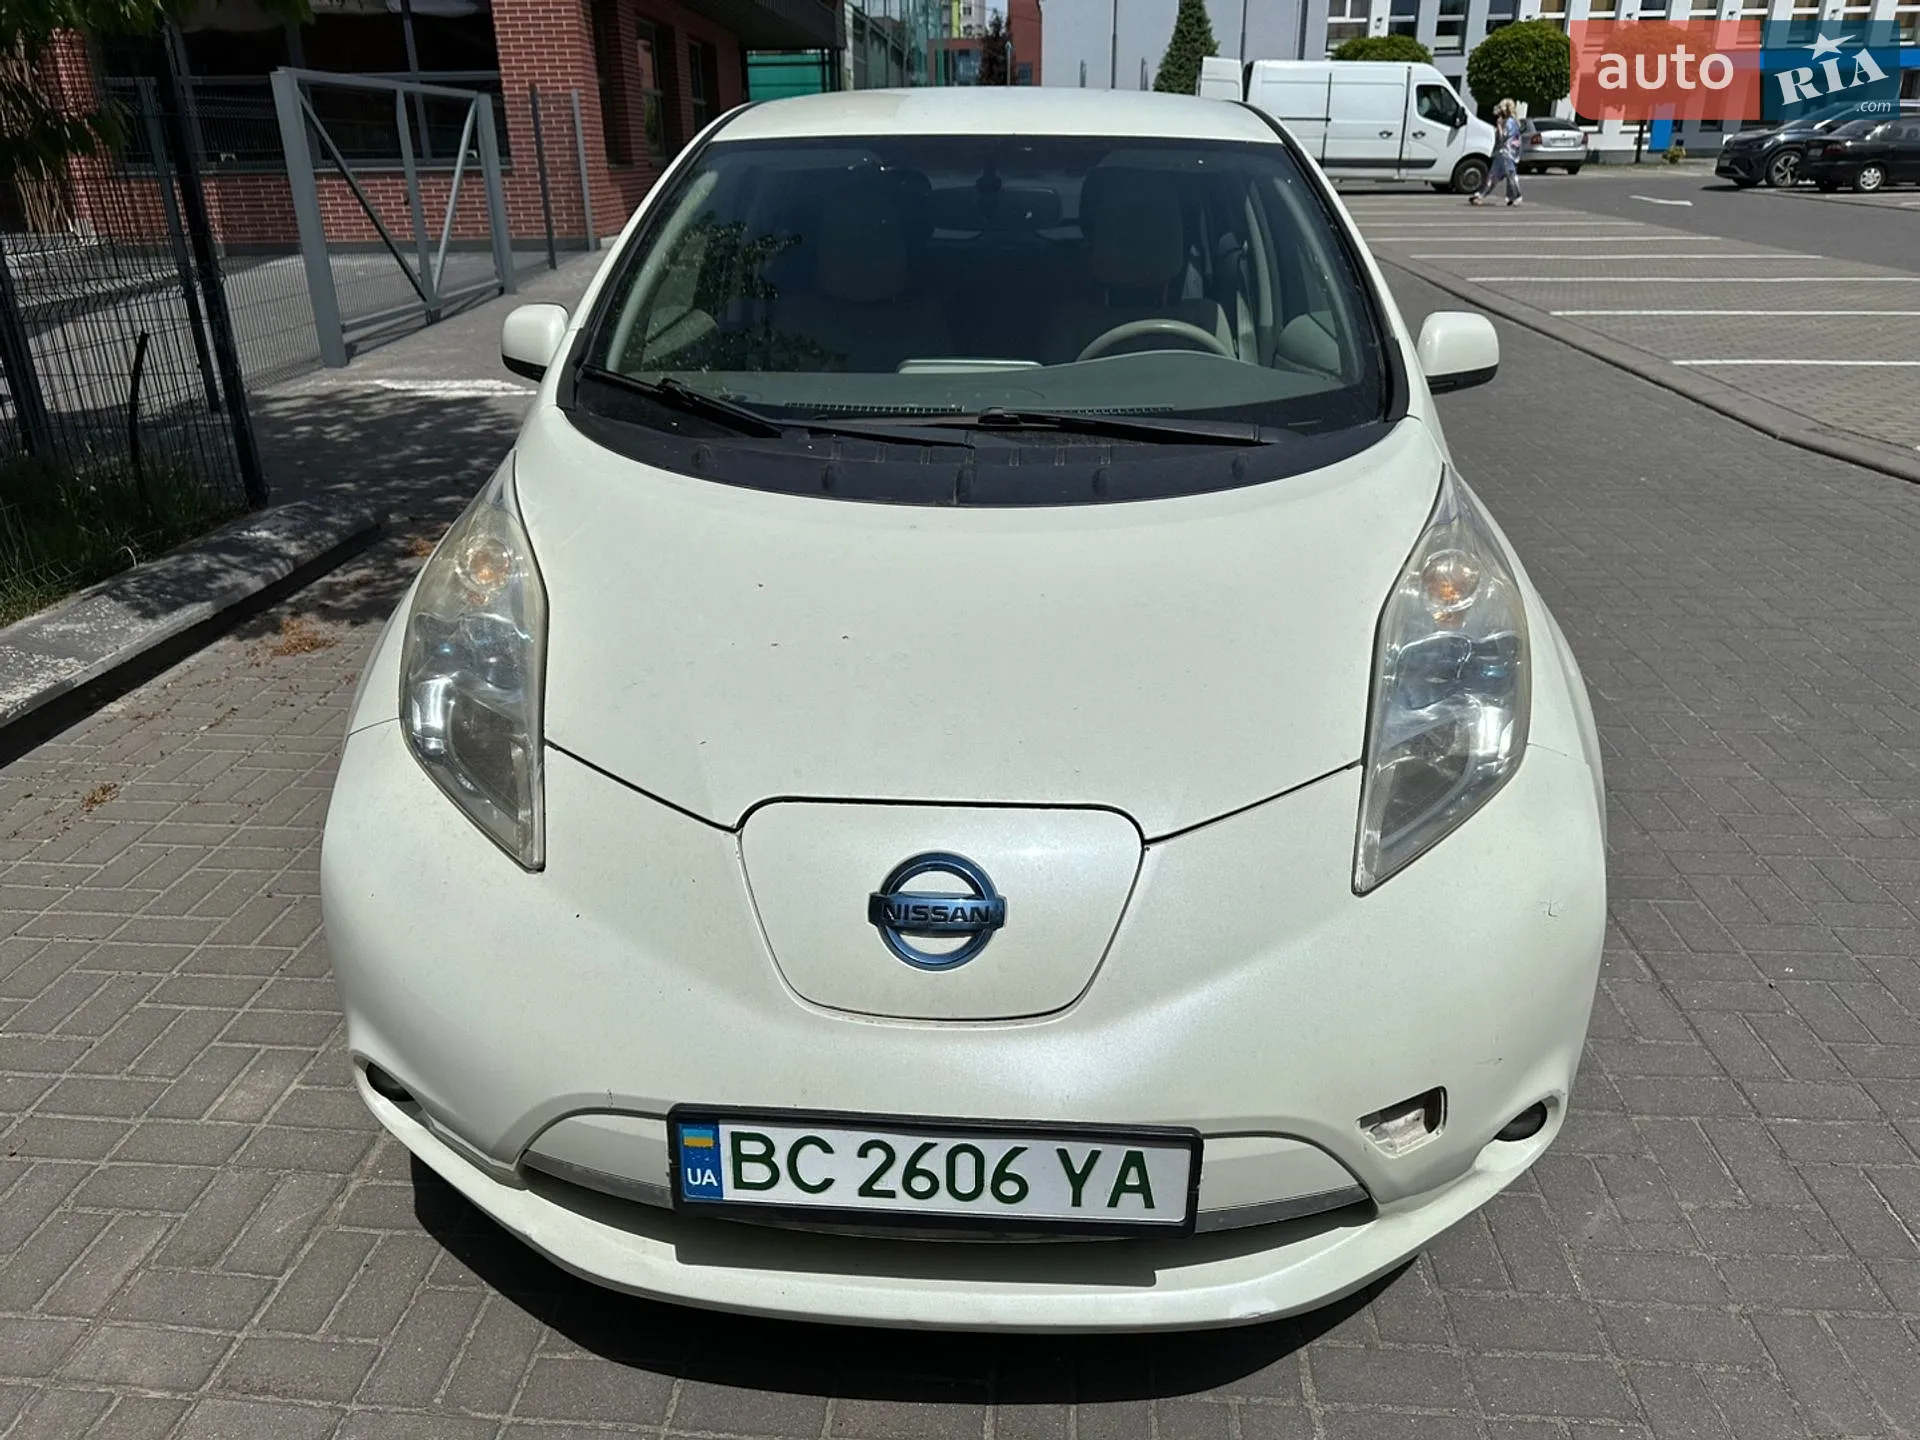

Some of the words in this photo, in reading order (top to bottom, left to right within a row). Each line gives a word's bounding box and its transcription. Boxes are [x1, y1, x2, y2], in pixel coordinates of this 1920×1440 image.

[883, 903, 990, 923] NISSAN
[686, 1166, 718, 1187] UA
[730, 1131, 835, 1194] BC
[857, 1139, 1029, 1204] 2606
[1056, 1147, 1155, 1209] YA
